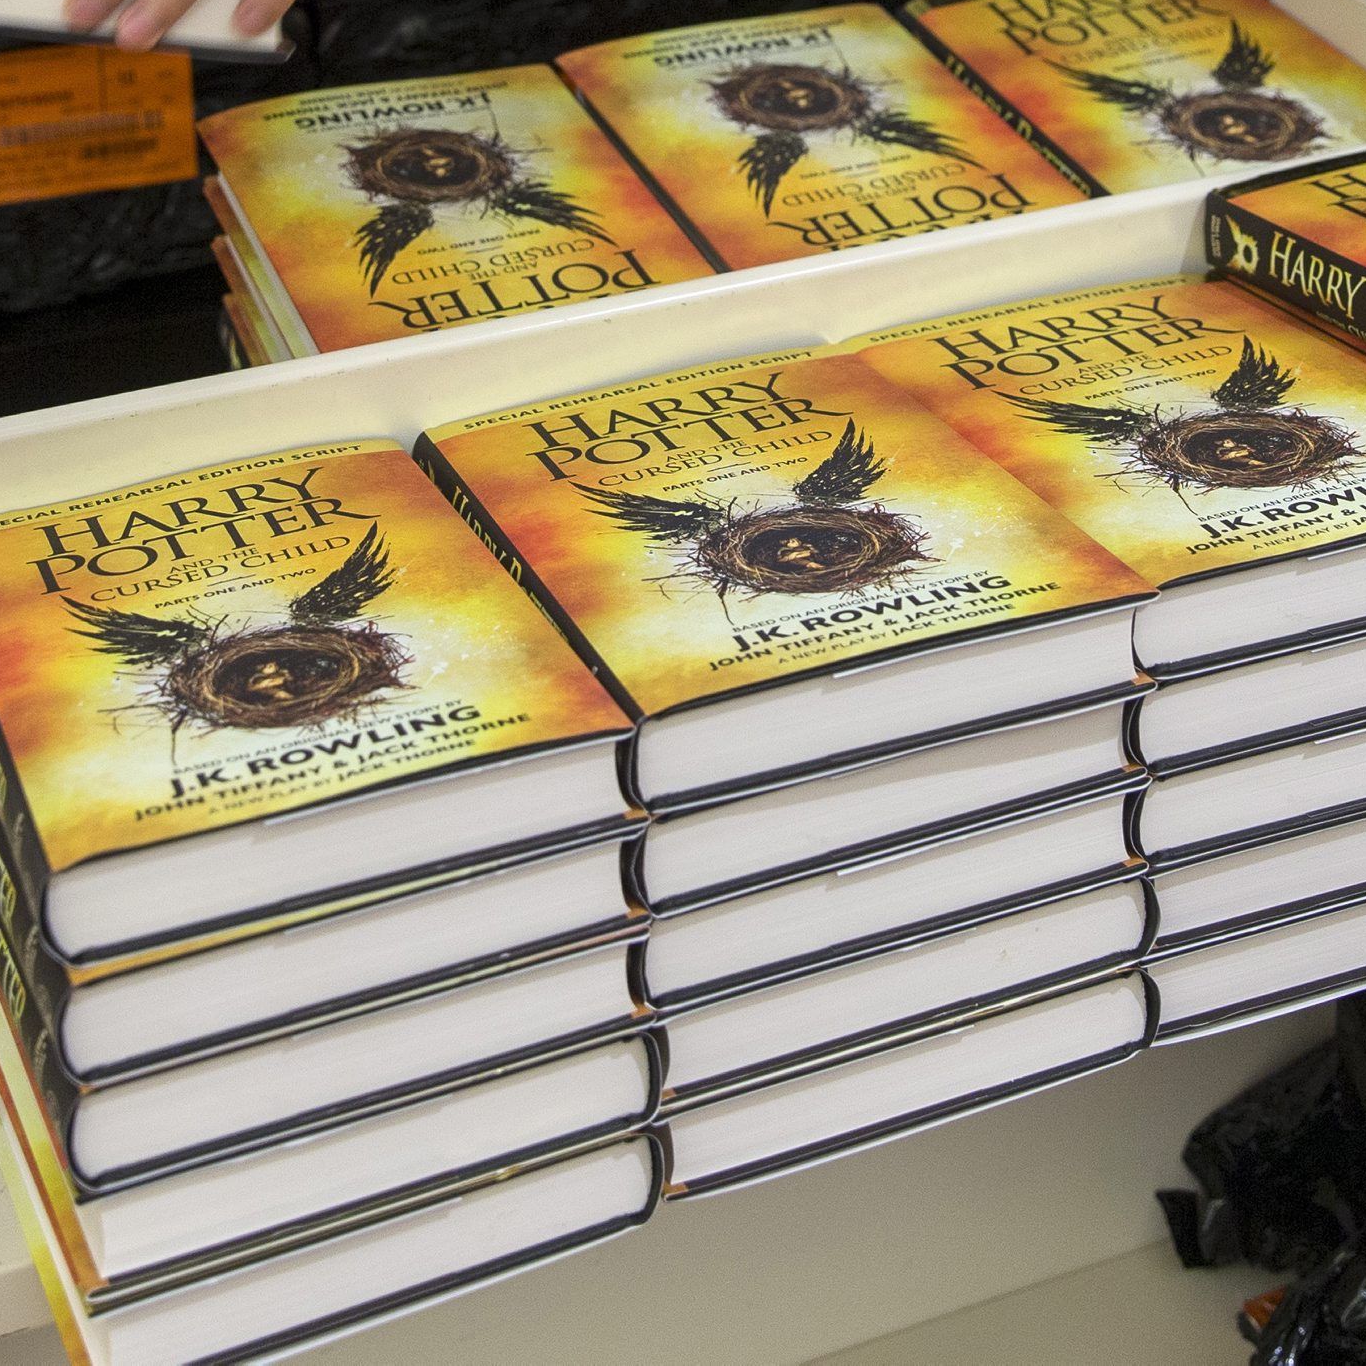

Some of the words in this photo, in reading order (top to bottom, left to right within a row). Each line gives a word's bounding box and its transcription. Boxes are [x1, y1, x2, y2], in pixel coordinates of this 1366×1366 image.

[294, 100, 445, 130] ROWLING
[782, 183, 864, 207] CHILD
[869, 163, 966, 188] CURSED
[766, 173, 1035, 246] POTTER
[392, 260, 481, 285] CHILD
[489, 238, 595, 266] CURSED
[368, 248, 661, 331] POTTER
[870, 324, 941, 343] SPECIAL
[947, 302, 1047, 326] REHEARSAL
[1053, 287, 1125, 306] EDITION
[926, 295, 1179, 362] HARRY
[939, 316, 1246, 391] POTTER
[464, 408, 544, 430] SPECIAL
[548, 380, 661, 410] REHEARSAL
[665, 364, 745, 385] EDITION
[749, 351, 812, 366] SCRIPT
[1019, 366, 1133, 396] CURSED
[1140, 345, 1233, 372] CHILD
[1077, 362, 1115, 375] AND
[1117, 353, 1151, 365] THE
[1085, 388, 1123, 401] PARTS
[1124, 382, 1153, 393] ONE
[1155, 375, 1183, 386] AND
[1185, 369, 1217, 380] TWO
[522, 372, 793, 449] HARRY
[526, 398, 854, 482] POTTER
[598, 454, 723, 487] CURSED
[733, 430, 833, 458] CHILD
[665, 448, 708, 463] AND
[708, 440, 747, 452] THE
[68, 480, 192, 511] REHEARSAL
[198, 457, 285, 482] EDITION
[291, 445, 362, 461] SCRIPT
[662, 478, 706, 492] PARTS
[706, 470, 738, 483] ONE
[740, 464, 771, 476] AND
[773, 457, 809, 470] TWO
[34, 467, 325, 557] HARRY
[1186, 535, 1244, 555] JOHN
[1246, 512, 1336, 539] TIFFANY
[1342, 505, 1357, 515] &
[1198, 508, 1238, 523] BASED
[1240, 503, 1261, 513] ON
[1263, 498, 1282, 508] AN
[1283, 485, 1340, 503] ORIGINAL
[1200, 515, 1263, 539] J.K.
[26, 498, 382, 595] POTTER
[169, 557, 214, 573] AND
[219, 547, 259, 560] THE
[1265, 536, 1297, 548] NEW
[1299, 526, 1330, 540] PLAY
[1334, 522, 1349, 530] BY
[91, 564, 230, 602] CURSED
[240, 536, 351, 568] CHILD
[154, 593, 201, 609] PARTS
[204, 585, 237, 598] ONE
[241, 577, 275, 590] AND
[280, 568, 317, 582] TWO
[709, 648, 772, 671] JOHN
[776, 623, 877, 652] TIFFANY
[884, 615, 900, 625] &
[904, 603, 959, 623] JACK
[963, 582, 1061, 606] THORNE
[732, 619, 776, 633] BASED
[780, 612, 802, 623] ON
[802, 607, 826, 618] AN
[828, 593, 891, 612] ORIGINAL
[929, 574, 972, 589] STORY
[974, 569, 990, 578] BY
[732, 624, 800, 653] J.K.
[800, 575, 1012, 631] ROWLING
[891, 620, 937, 637] JACK
[938, 603, 1017, 622] THORNE
[135, 794, 206, 821] JOHN
[214, 766, 323, 799] TIFFANY
[332, 757, 349, 768] &
[356, 737, 416, 765] JACK
[428, 713, 532, 744] THORNE
[170, 767, 242, 799] J.K.
[249, 705, 482, 776] ROWLING
[338, 764, 391, 783] JACK
[394, 739, 477, 767] THORNE
